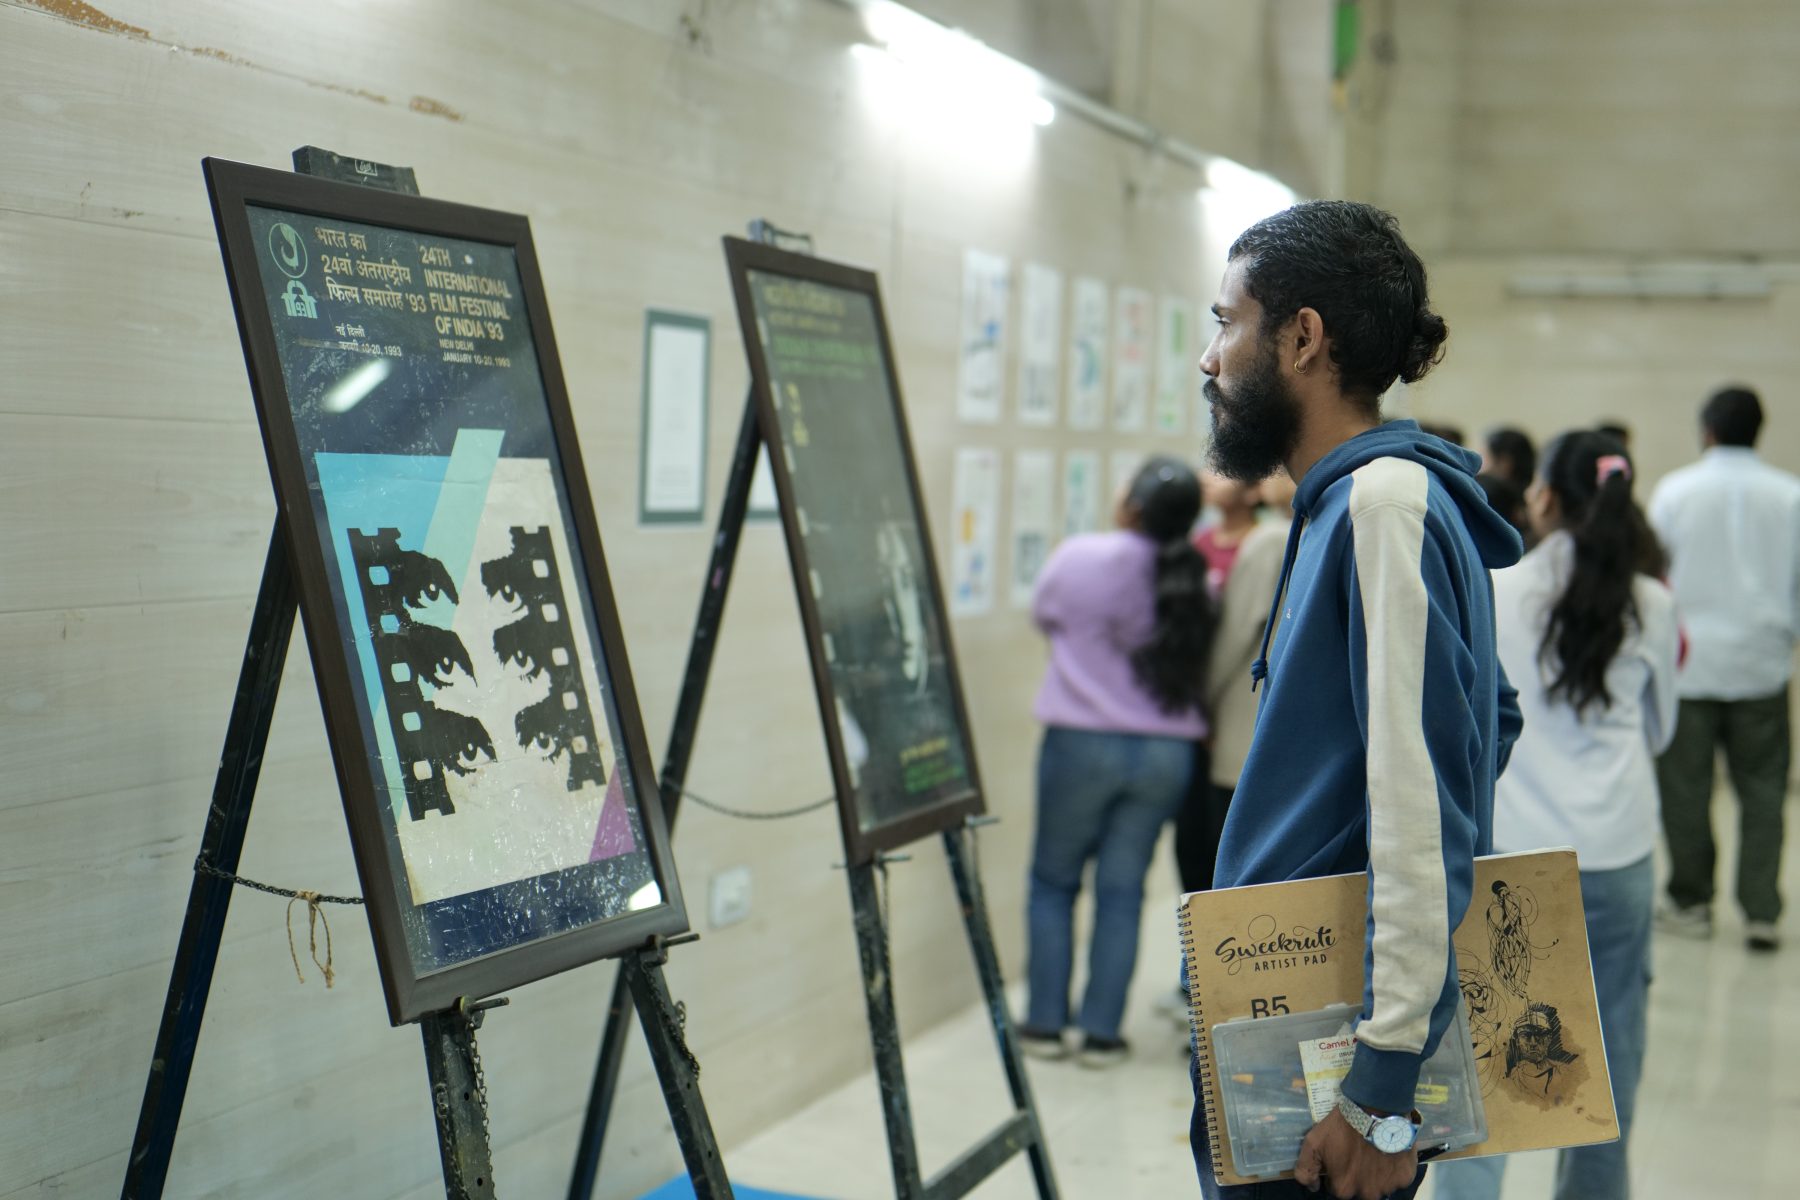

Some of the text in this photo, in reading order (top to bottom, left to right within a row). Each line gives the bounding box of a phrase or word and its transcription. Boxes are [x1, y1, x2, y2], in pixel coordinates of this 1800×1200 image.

[315, 227, 367, 252] भारत का
[321, 252, 353, 276] 24वां
[420, 246, 451, 267] 24TH
[326, 276, 427, 313] फिल्म समारोह '93
[424, 269, 512, 298] INTERNATIONAL
[429, 292, 511, 320] FILM FESTIVAL
[435, 315, 504, 341] OF INDIA '93
[384, 345, 402, 357] 1993
[439, 338, 474, 352] NEW DELHI
[442, 352, 472, 364] JANUARY
[1215, 914, 1338, 976] Sweekruti
[1254, 953, 1327, 972] ARTIST PAD
[1250, 995, 1290, 1019] B5
[1319, 1038, 1350, 1051] Camel
